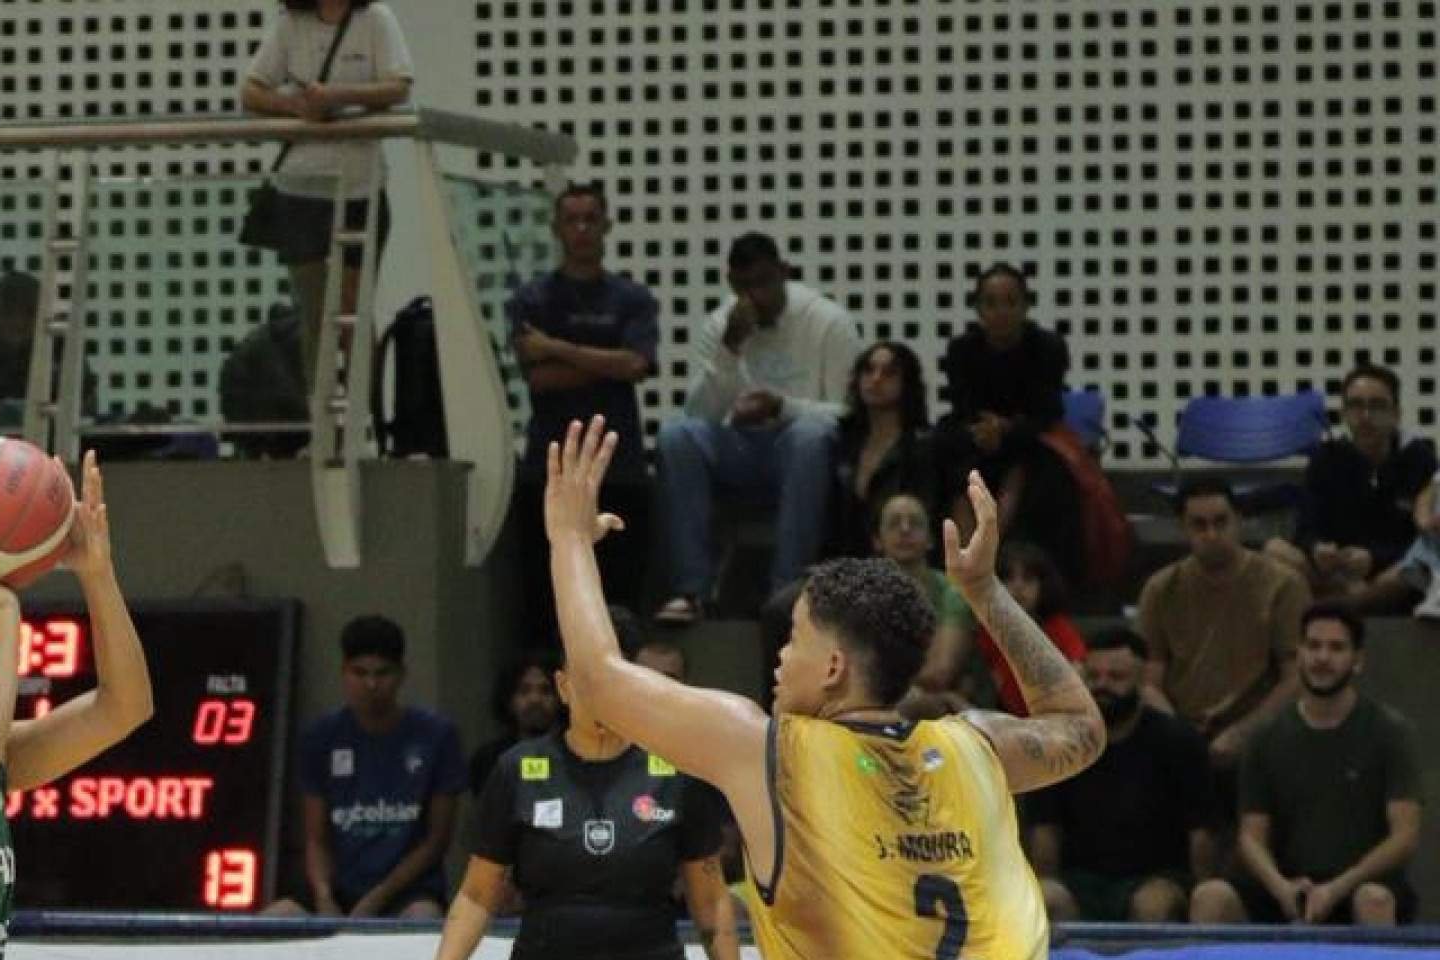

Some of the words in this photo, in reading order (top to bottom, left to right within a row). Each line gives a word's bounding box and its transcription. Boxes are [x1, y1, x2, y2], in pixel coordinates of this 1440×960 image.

[192, 701, 256, 746] 03
[70, 777, 213, 819] SPORT
[898, 830, 974, 863] MOURA
[205, 850, 256, 907] 13
